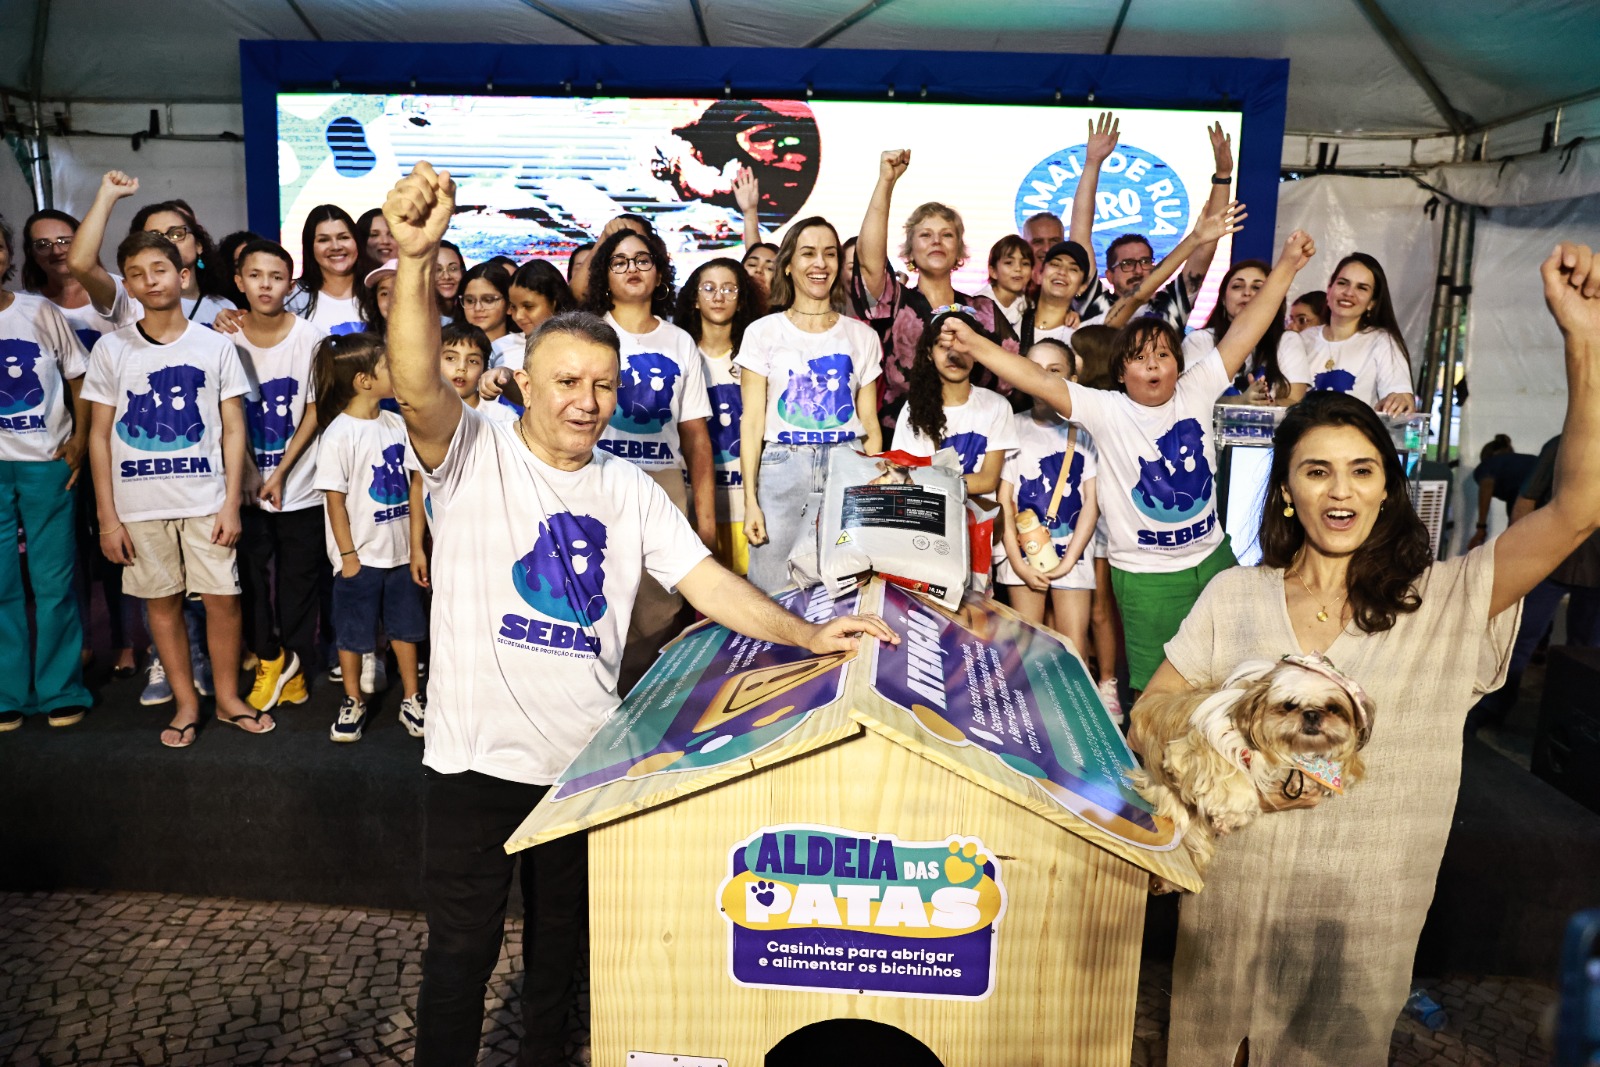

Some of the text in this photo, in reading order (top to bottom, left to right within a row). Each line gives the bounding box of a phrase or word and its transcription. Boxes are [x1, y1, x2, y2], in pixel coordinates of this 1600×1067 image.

[1022, 152, 1181, 236] IMAL DE RUA
[1058, 188, 1141, 227] ZRO
[0, 415, 46, 430] BEM
[120, 457, 211, 477] SEBEM
[374, 504, 410, 522] SEBE
[1137, 508, 1216, 546] SEBEM
[540, 647, 569, 657] PROTEÇÃO
[899, 609, 948, 710] ATENÇÃO
[756, 833, 939, 880] ALDEIA DAS
[745, 882, 981, 929] PATAS
[758, 956, 962, 978] e alimentar os bichinhos
[766, 941, 954, 964] Casinhas para abrigar
